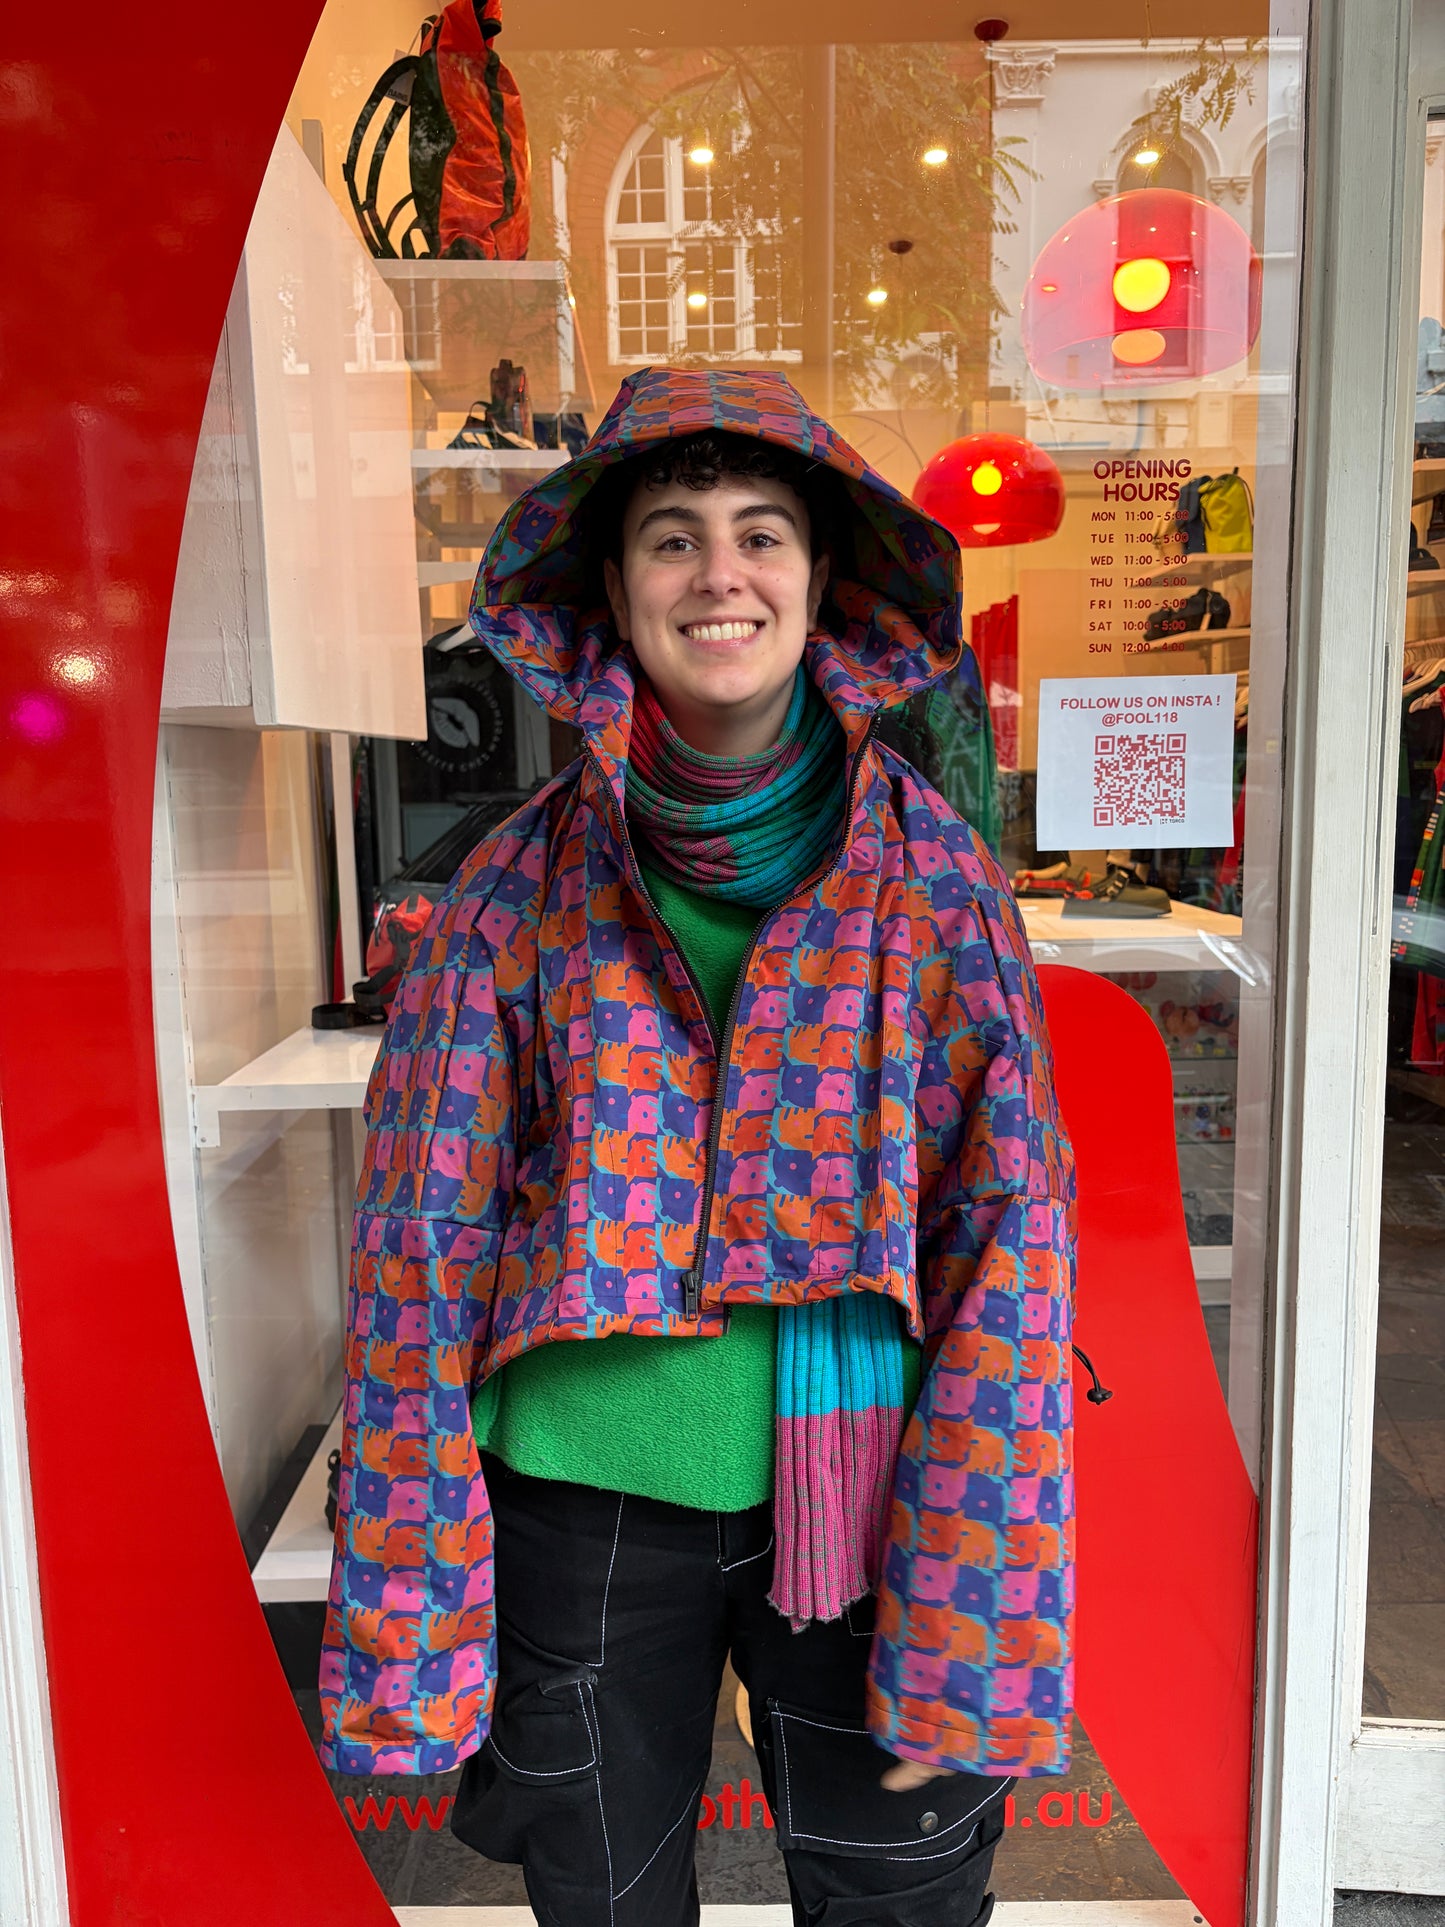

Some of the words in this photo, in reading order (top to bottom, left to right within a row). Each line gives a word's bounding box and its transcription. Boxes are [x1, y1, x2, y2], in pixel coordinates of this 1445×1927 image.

[1093, 458, 1192, 480] OPENING
[1103, 481, 1181, 502] HOURS
[1091, 511, 1116, 522] MON
[1125, 510, 1154, 521] 11:00
[1164, 510, 1189, 521] 5:00
[1091, 533, 1114, 544] TUE
[1124, 533, 1153, 544] 11:00
[1163, 532, 1189, 544] 5:00
[1090, 556, 1114, 566] WED
[1124, 555, 1153, 565] 11:00
[1163, 555, 1188, 566] 5:00
[1090, 577, 1113, 588] THU
[1123, 577, 1152, 588] 11:00
[1162, 576, 1187, 587] 5:00
[1089, 599, 1112, 609] FRI
[1123, 599, 1152, 609] 11:00
[1162, 598, 1187, 609] 5:00
[1089, 621, 1112, 632] SAT
[1122, 621, 1151, 631] 10:00
[1161, 621, 1186, 631] 5:00
[1088, 643, 1112, 653] SUN
[1122, 642, 1151, 653] 12:00
[1161, 642, 1185, 652] 4:00
[1060, 697, 1121, 710] FOLLOW
[1123, 696, 1143, 709] US
[1146, 696, 1168, 708] ON
[1171, 695, 1213, 707] INSTA
[1101, 711, 1178, 728] @FOOL118
